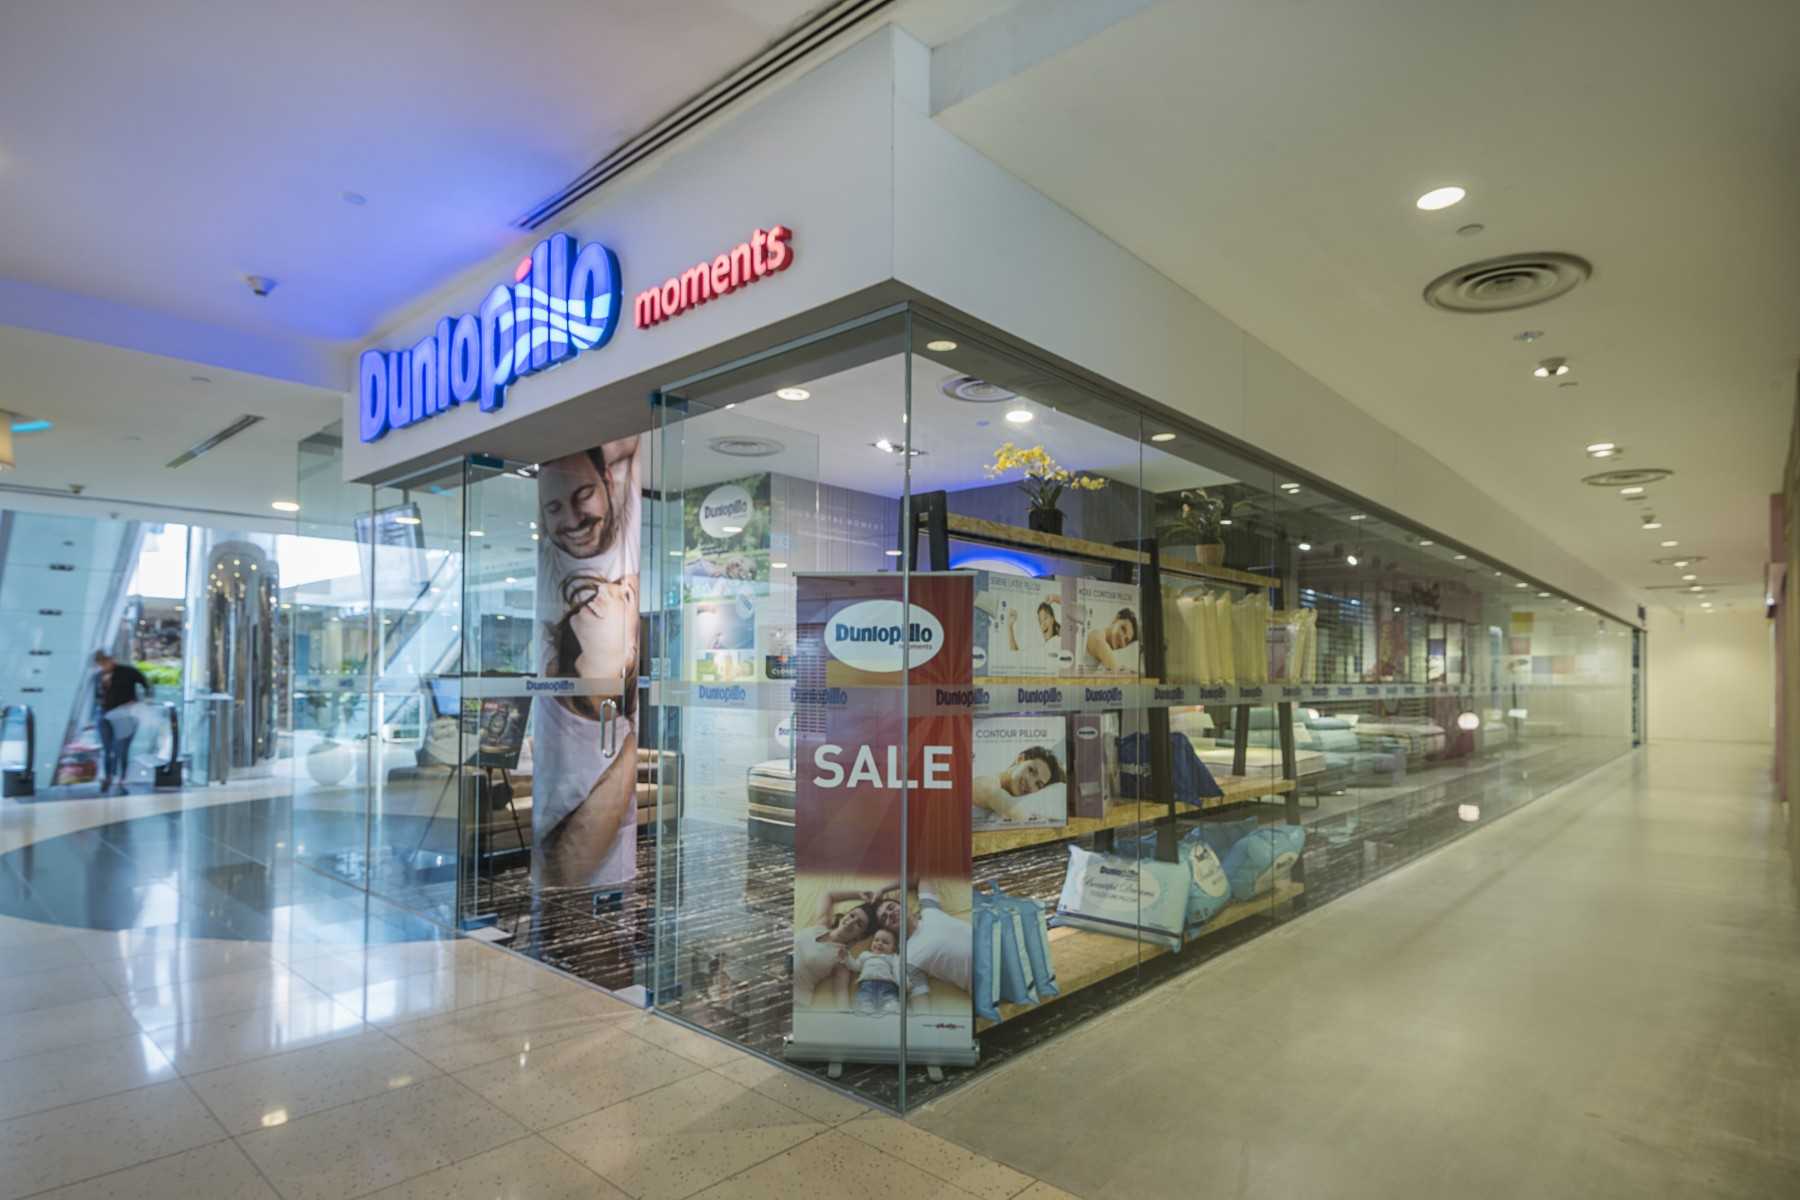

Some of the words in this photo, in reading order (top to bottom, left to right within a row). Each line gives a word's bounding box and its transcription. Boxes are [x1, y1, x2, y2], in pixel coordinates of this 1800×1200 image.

[360, 233, 622, 443] Dunlopillo
[634, 225, 794, 330] moments
[699, 685, 746, 702] Dunlopillo
[936, 688, 990, 708] Dunlopillo
[1018, 687, 1062, 705] Dunlopillo
[976, 729, 1017, 739] CONTOUR
[1019, 729, 1047, 738] PILLOW
[813, 744, 953, 789] SALE
